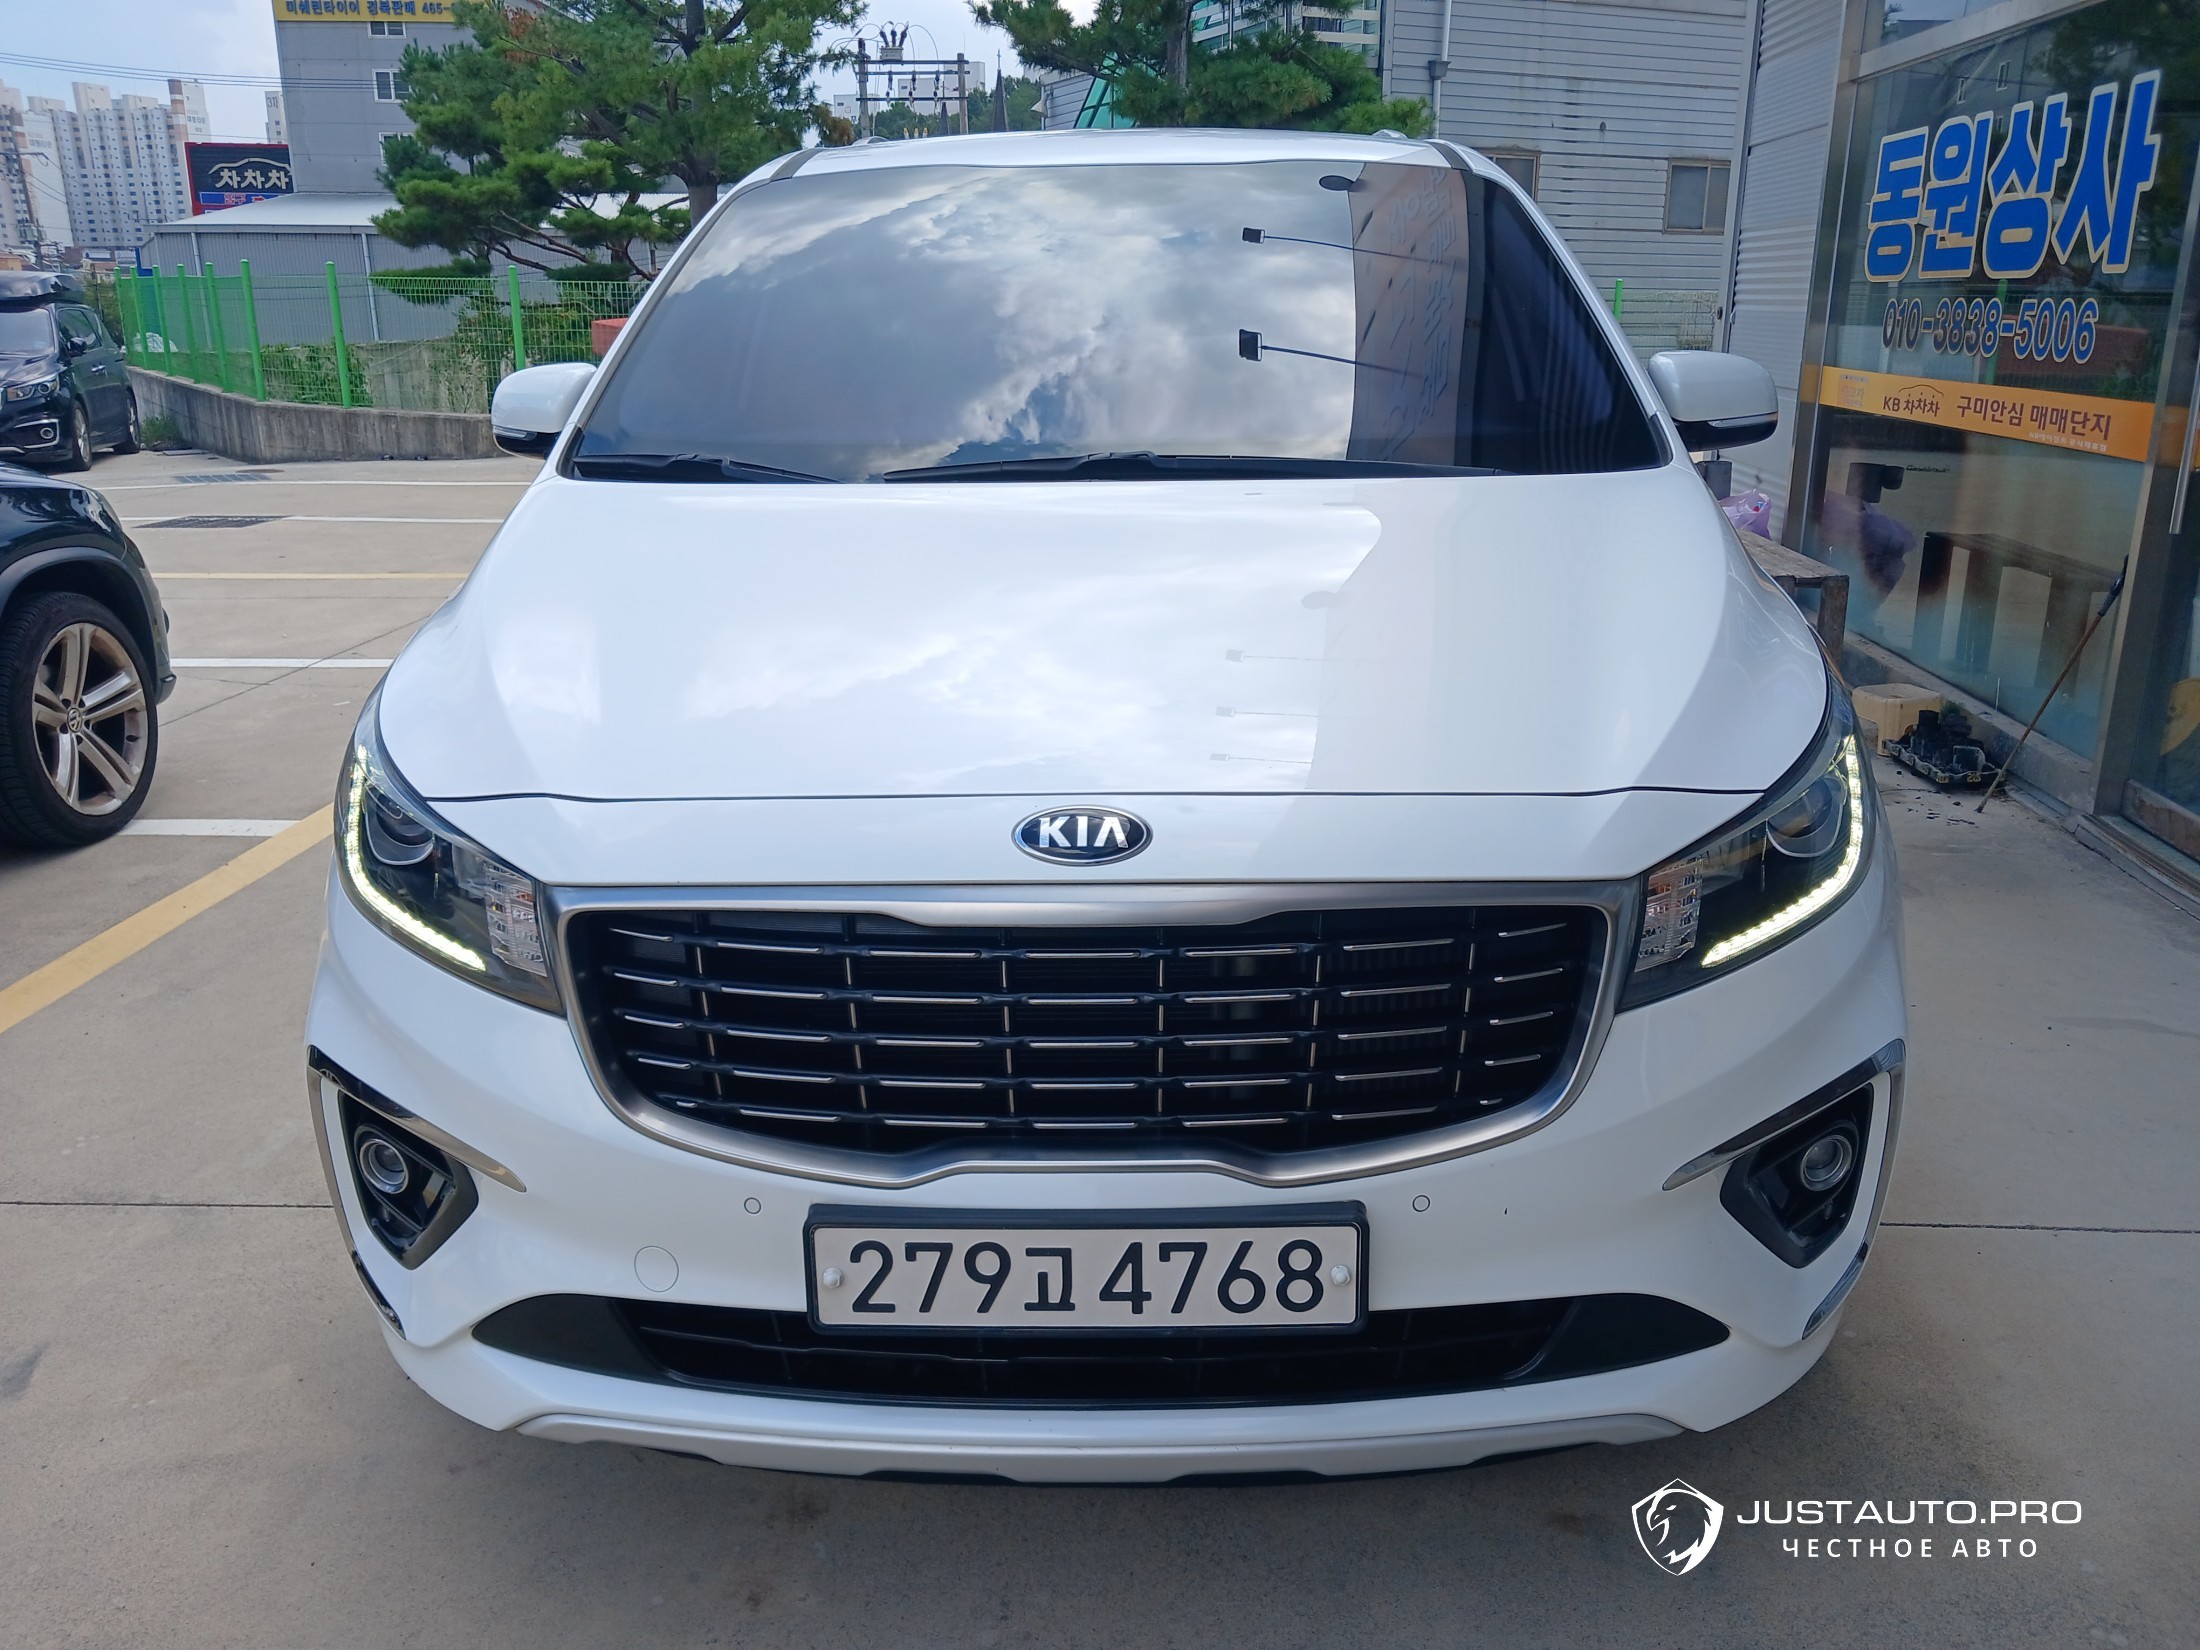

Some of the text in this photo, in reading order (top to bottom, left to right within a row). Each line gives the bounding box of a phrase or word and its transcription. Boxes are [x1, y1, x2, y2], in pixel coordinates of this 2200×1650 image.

[215, 168, 290, 190] 차차차
[1864, 69, 2162, 283] 동원상사
[1882, 297, 2099, 364] 010-3838-5006
[1883, 392, 2112, 441] KB 차차차 구미안심 매매단지
[1039, 815, 1129, 848] KIA
